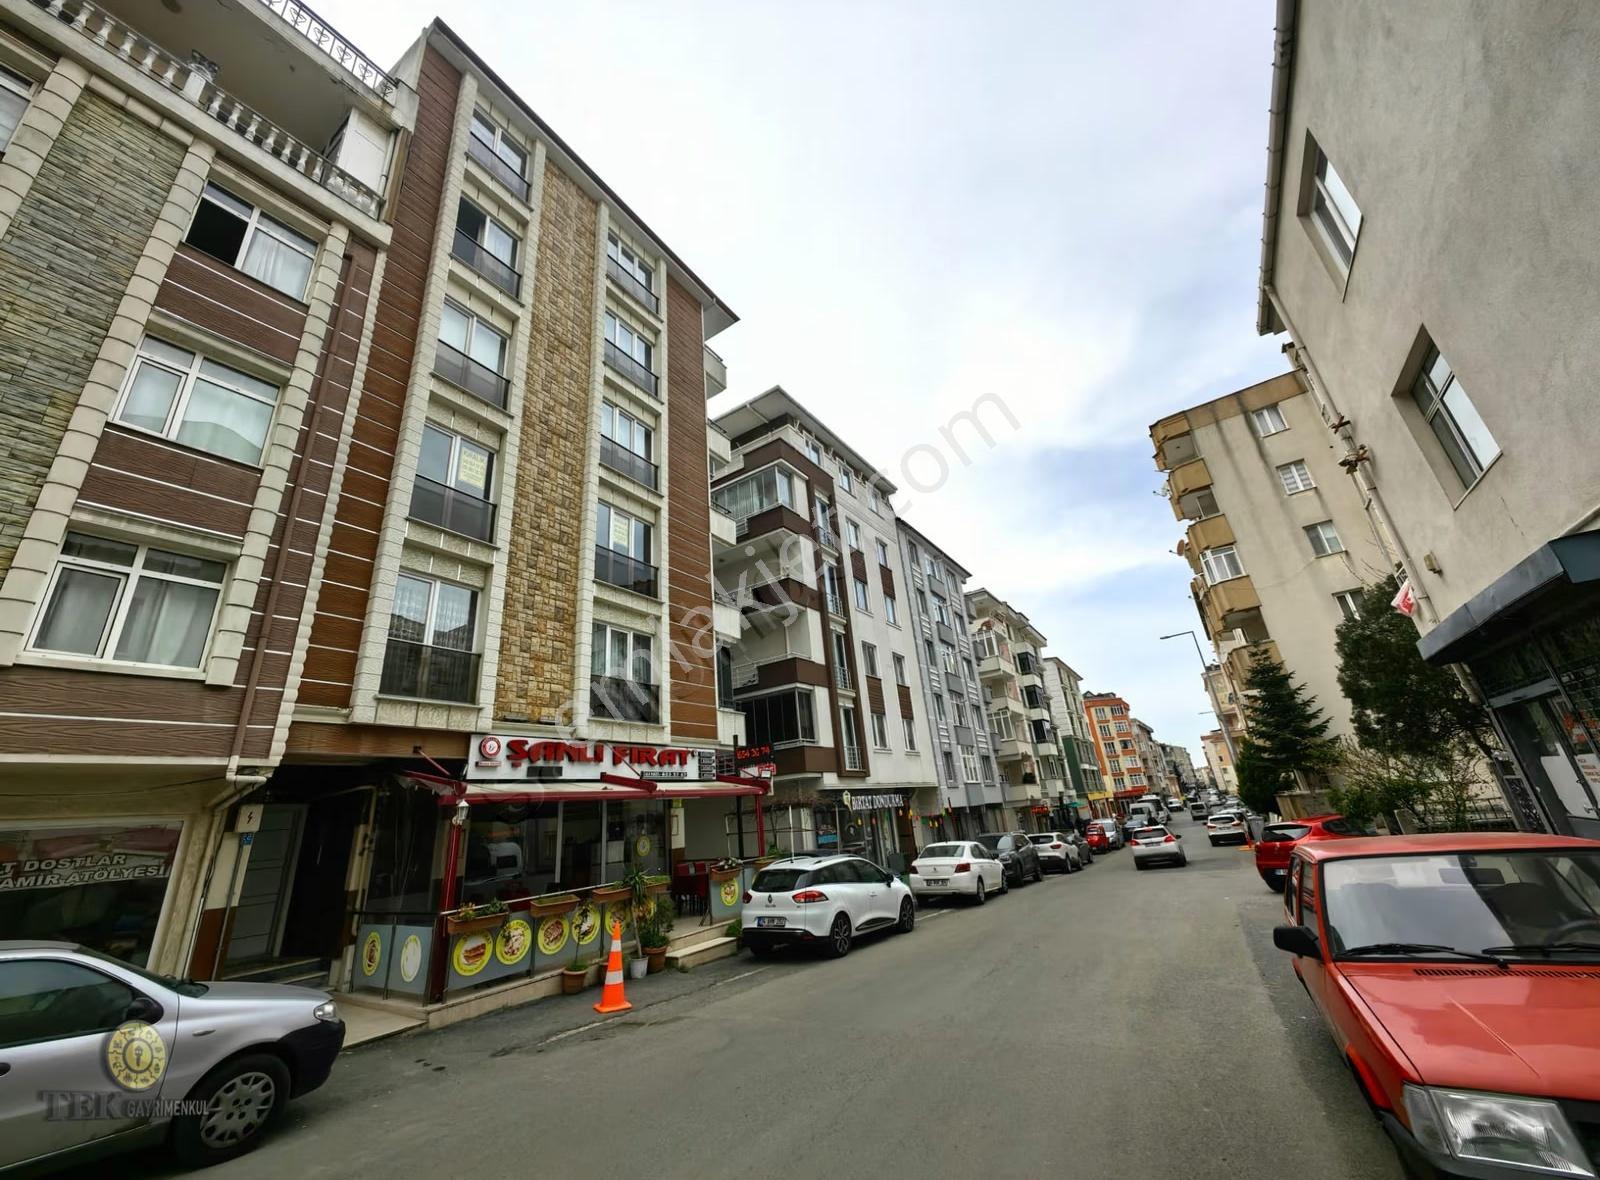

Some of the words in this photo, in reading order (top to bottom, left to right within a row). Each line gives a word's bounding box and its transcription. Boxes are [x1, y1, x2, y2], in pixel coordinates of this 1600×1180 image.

[506, 739, 604, 768] ŞANLI
[612, 745, 692, 767] FIRAT
[24, 854, 127, 872] DOSTLAR
